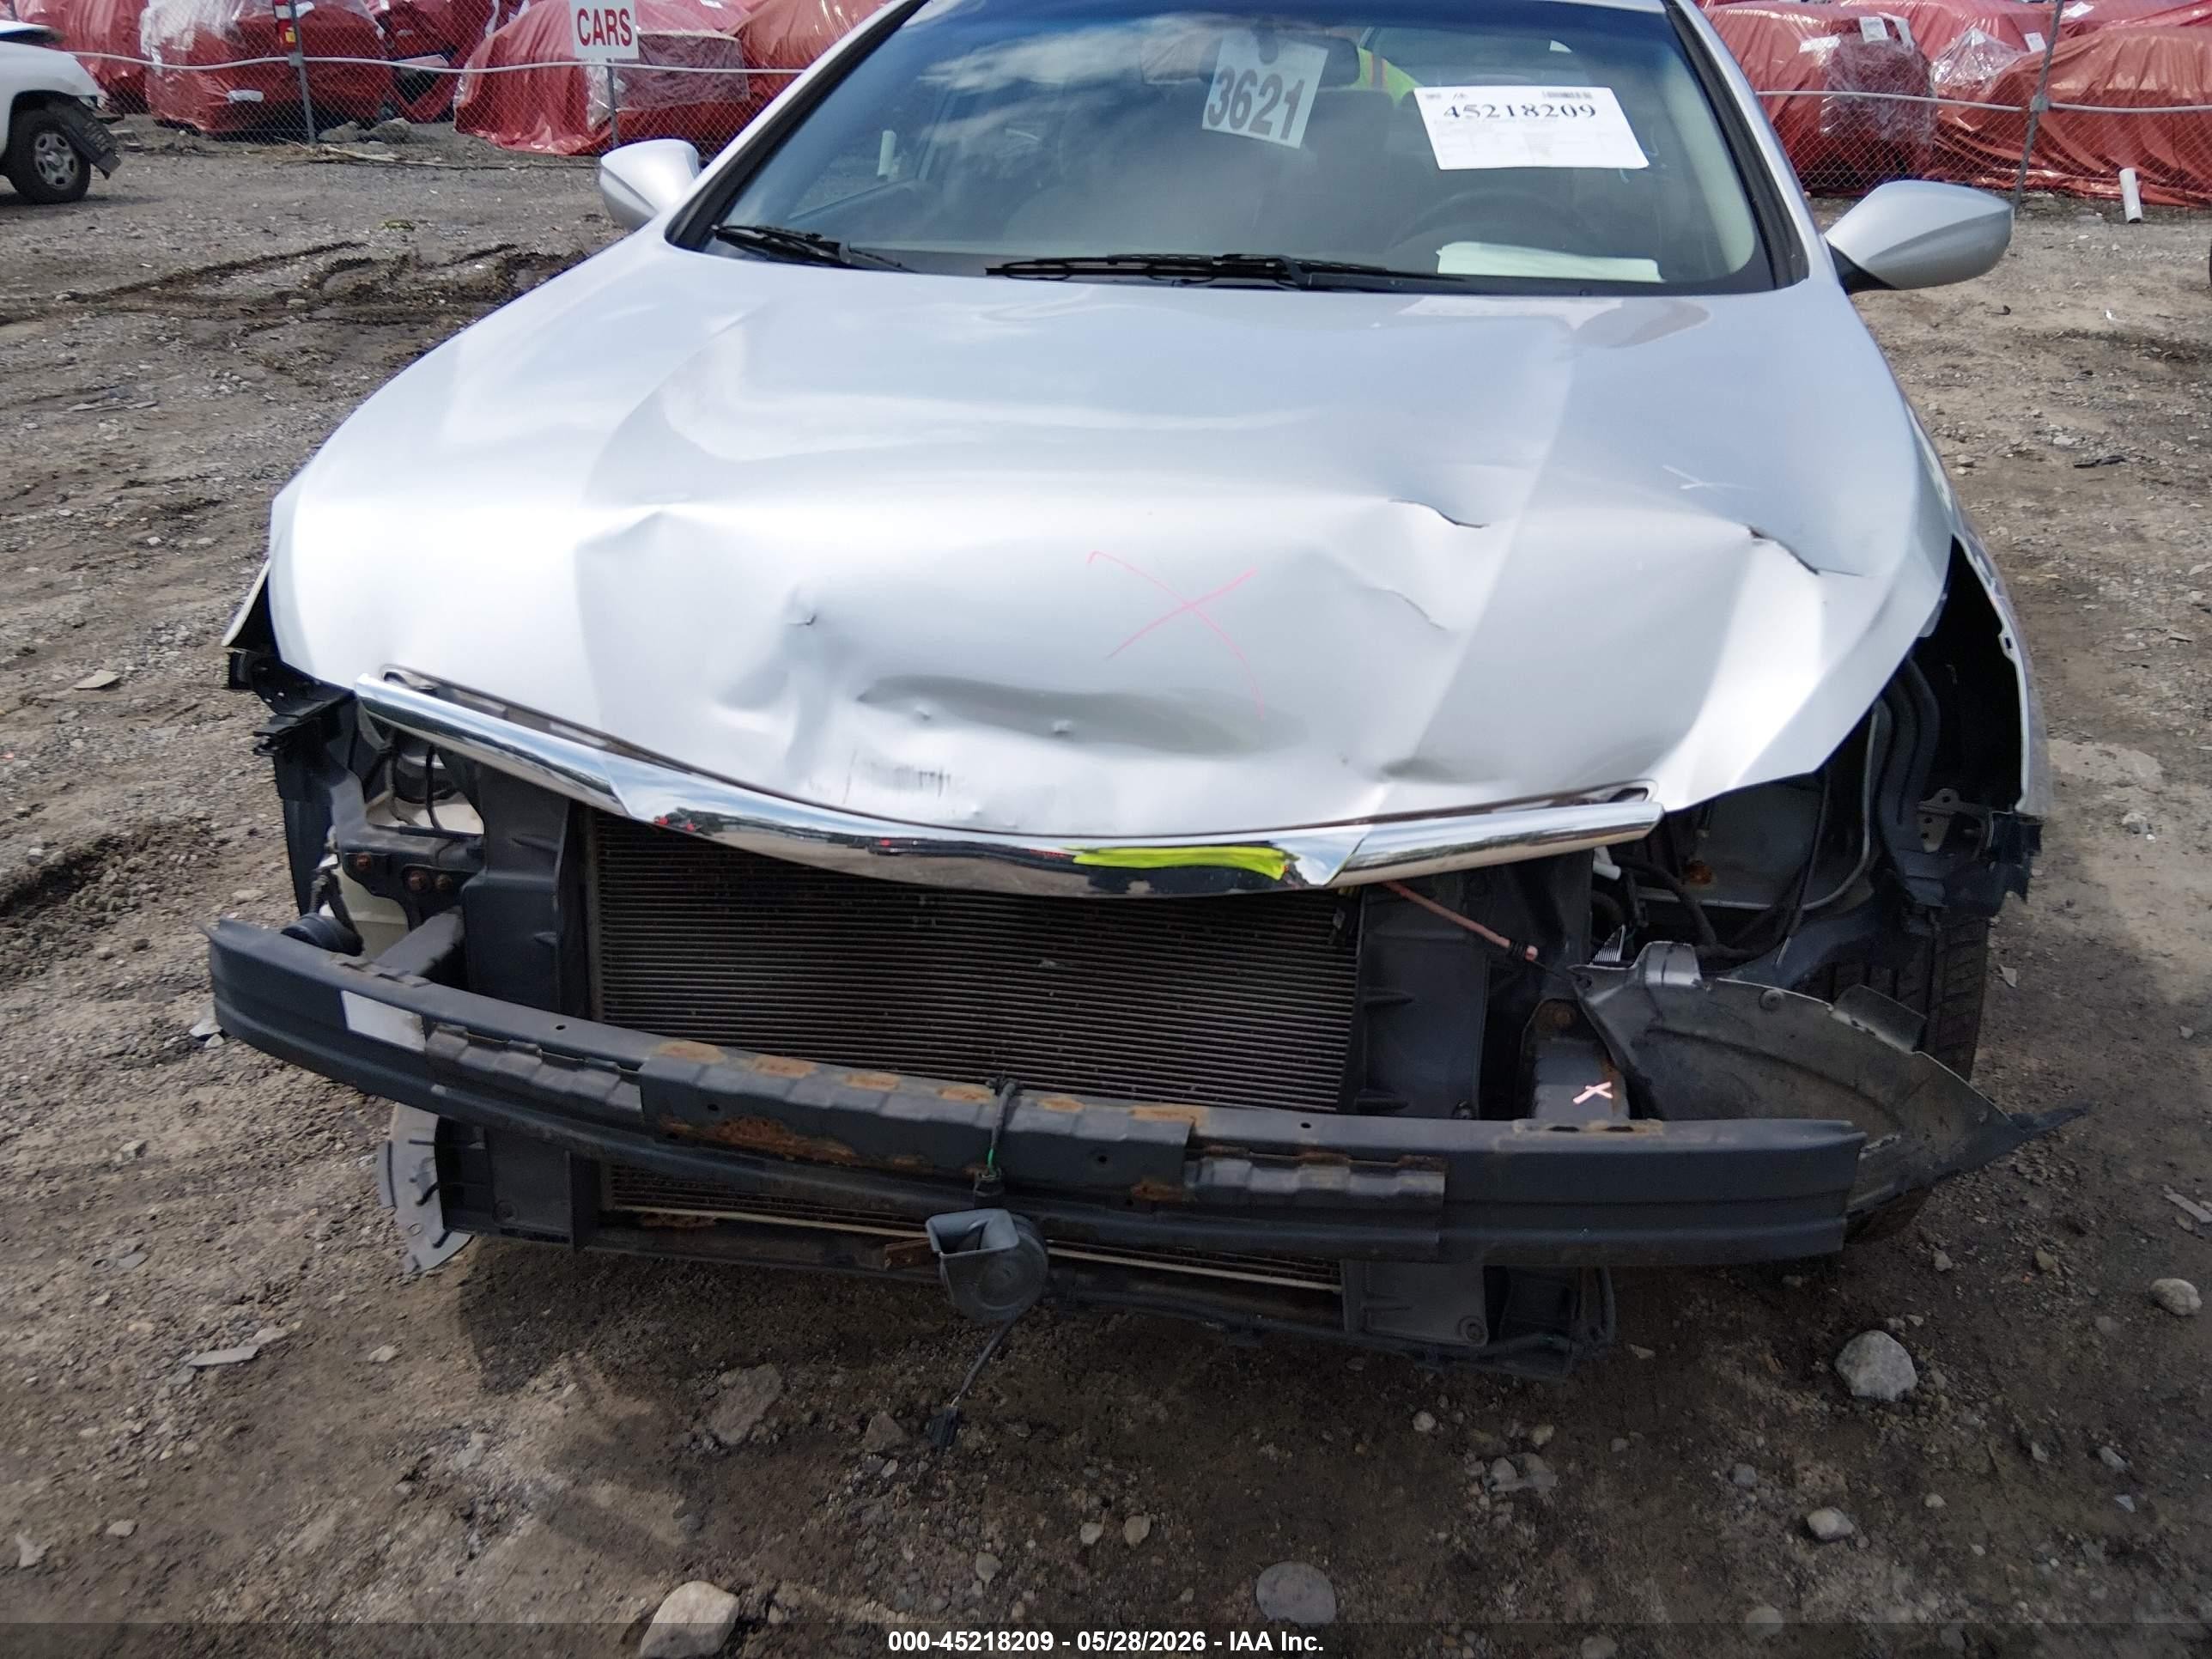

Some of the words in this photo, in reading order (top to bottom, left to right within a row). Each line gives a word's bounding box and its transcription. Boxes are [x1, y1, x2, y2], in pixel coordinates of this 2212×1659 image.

[577, 8, 632, 46] CARS
[1207, 65, 1305, 140] 3621
[1443, 100, 1596, 118] 45218209
